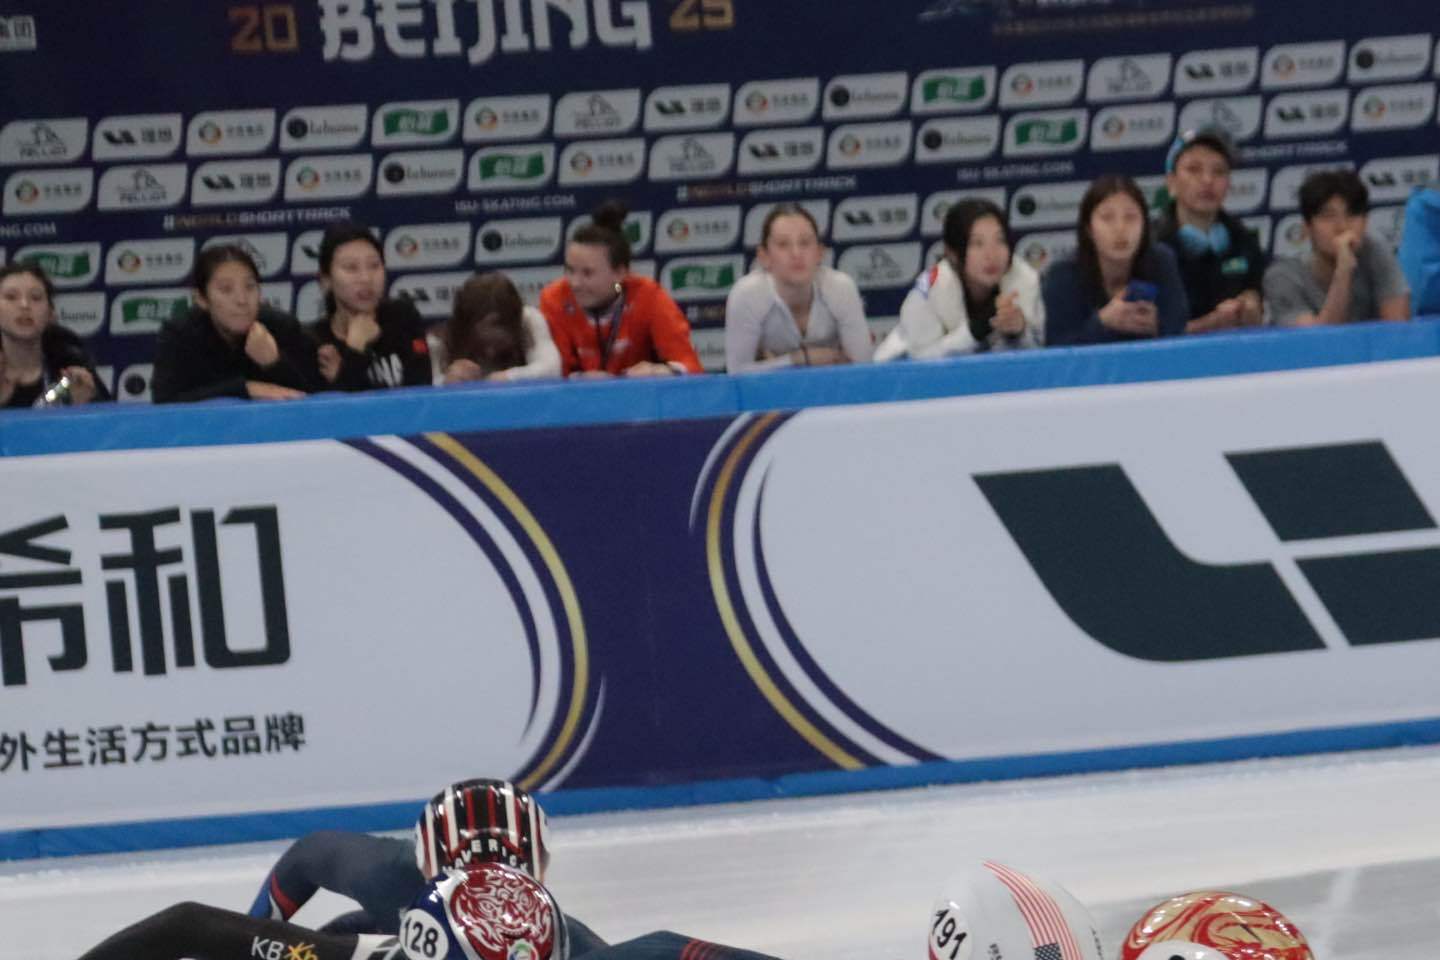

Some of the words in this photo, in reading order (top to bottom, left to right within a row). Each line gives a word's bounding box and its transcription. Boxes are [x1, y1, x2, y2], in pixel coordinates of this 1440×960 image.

[228, 5, 298, 53] 20
[318, 0, 652, 66] BEIJING
[405, 917, 440, 958] 128
[931, 908, 968, 960] 191
